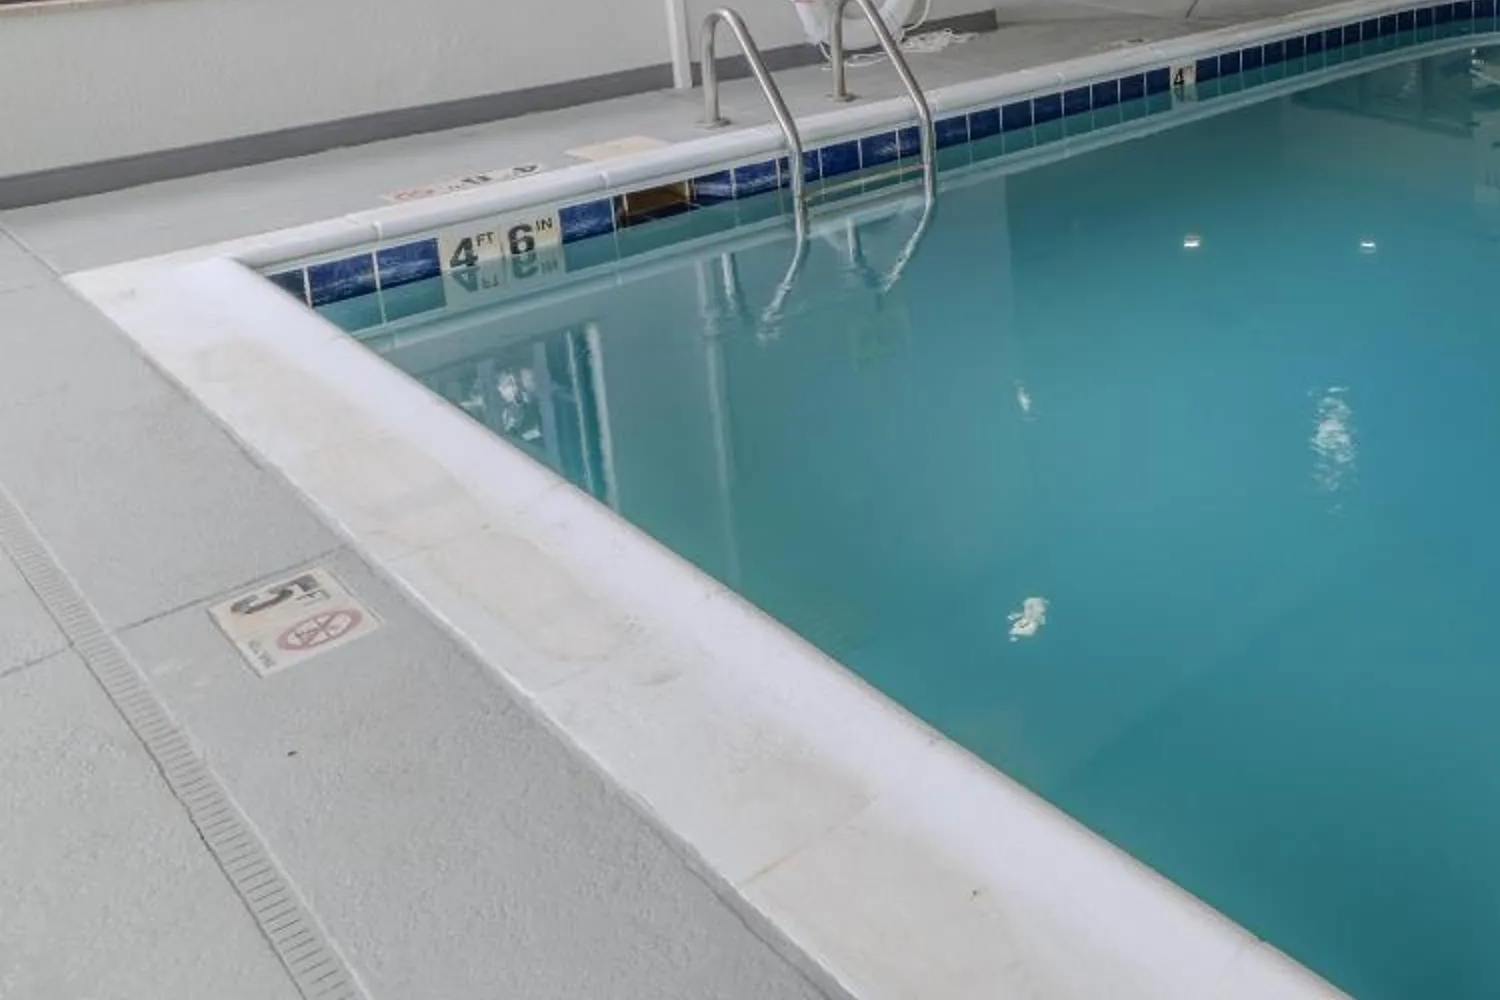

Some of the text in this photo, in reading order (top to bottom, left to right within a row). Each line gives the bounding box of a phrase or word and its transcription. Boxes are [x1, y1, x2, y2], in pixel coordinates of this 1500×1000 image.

[450, 216, 553, 268] 4 FT 6 IN
